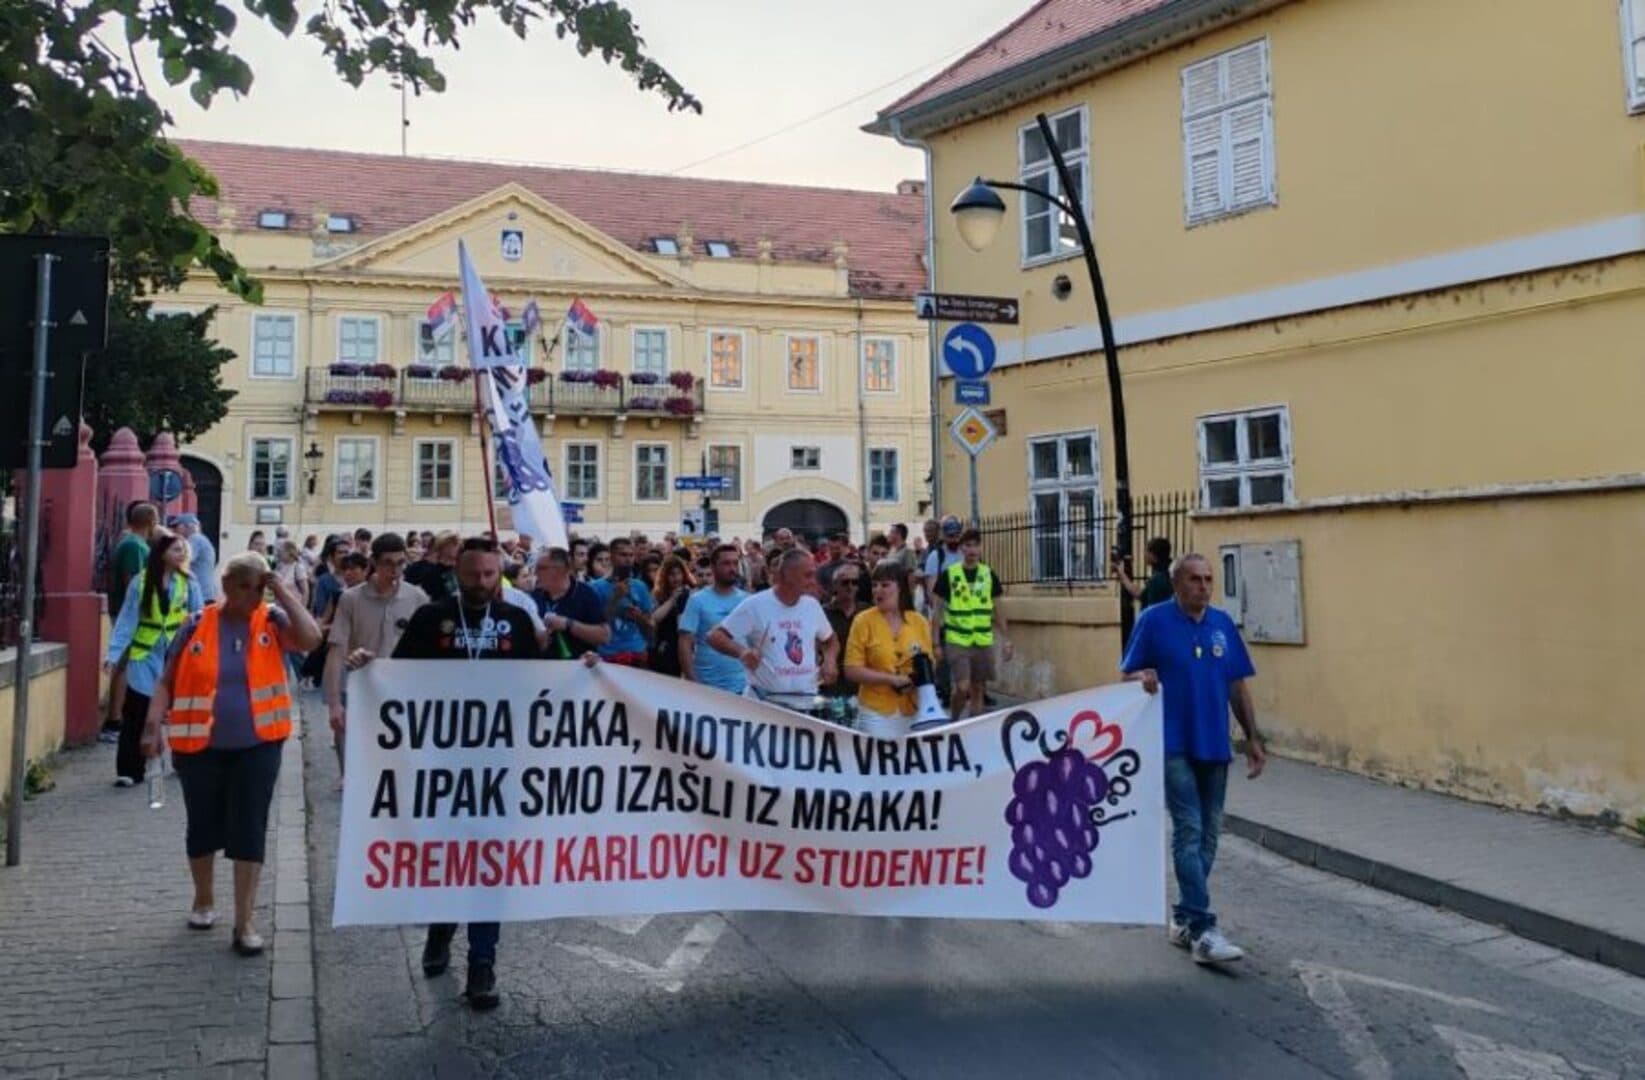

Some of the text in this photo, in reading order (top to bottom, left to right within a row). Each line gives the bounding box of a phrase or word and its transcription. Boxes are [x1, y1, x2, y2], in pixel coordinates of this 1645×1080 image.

[377, 689, 983, 778] SVUDA ĆAKA, NIOTKUDA VRATA,
[370, 762, 942, 832] A IPAK SMO IZAŠLI IZ MRAKA!
[364, 833, 986, 889] SREMSKI KARLOVCI UZ STUDENTE!
